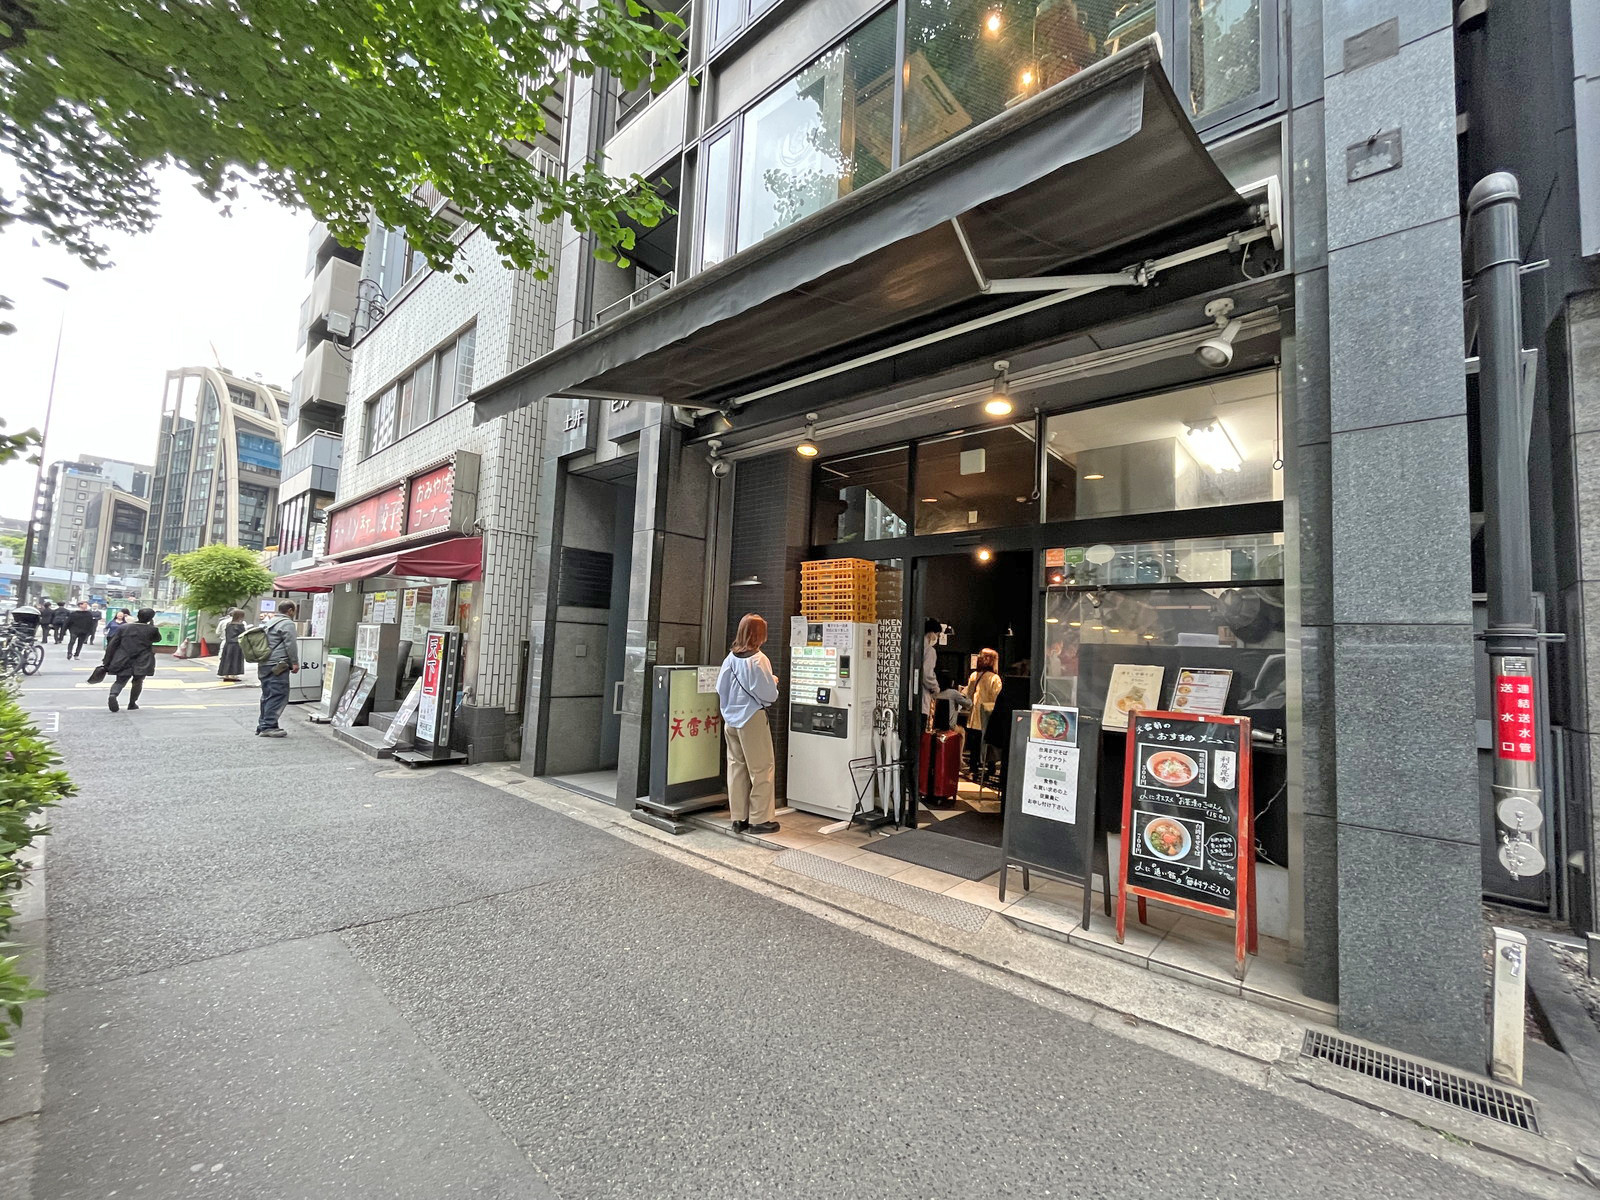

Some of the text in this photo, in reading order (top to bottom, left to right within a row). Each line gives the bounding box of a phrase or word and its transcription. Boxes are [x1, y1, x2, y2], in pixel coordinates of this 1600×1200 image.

[414, 506, 449, 527] コーナー
[425, 638, 438, 692] 天下一
[670, 715, 721, 742] 天雷軒
[1500, 683, 1515, 751] 送水口
[1517, 684, 1531, 753] 連結送水管
[1038, 755, 1067, 763] テイクアウト
[1039, 747, 1068, 756] 台湾まぜそば
[1033, 784, 1068, 796] お買い求めの上
